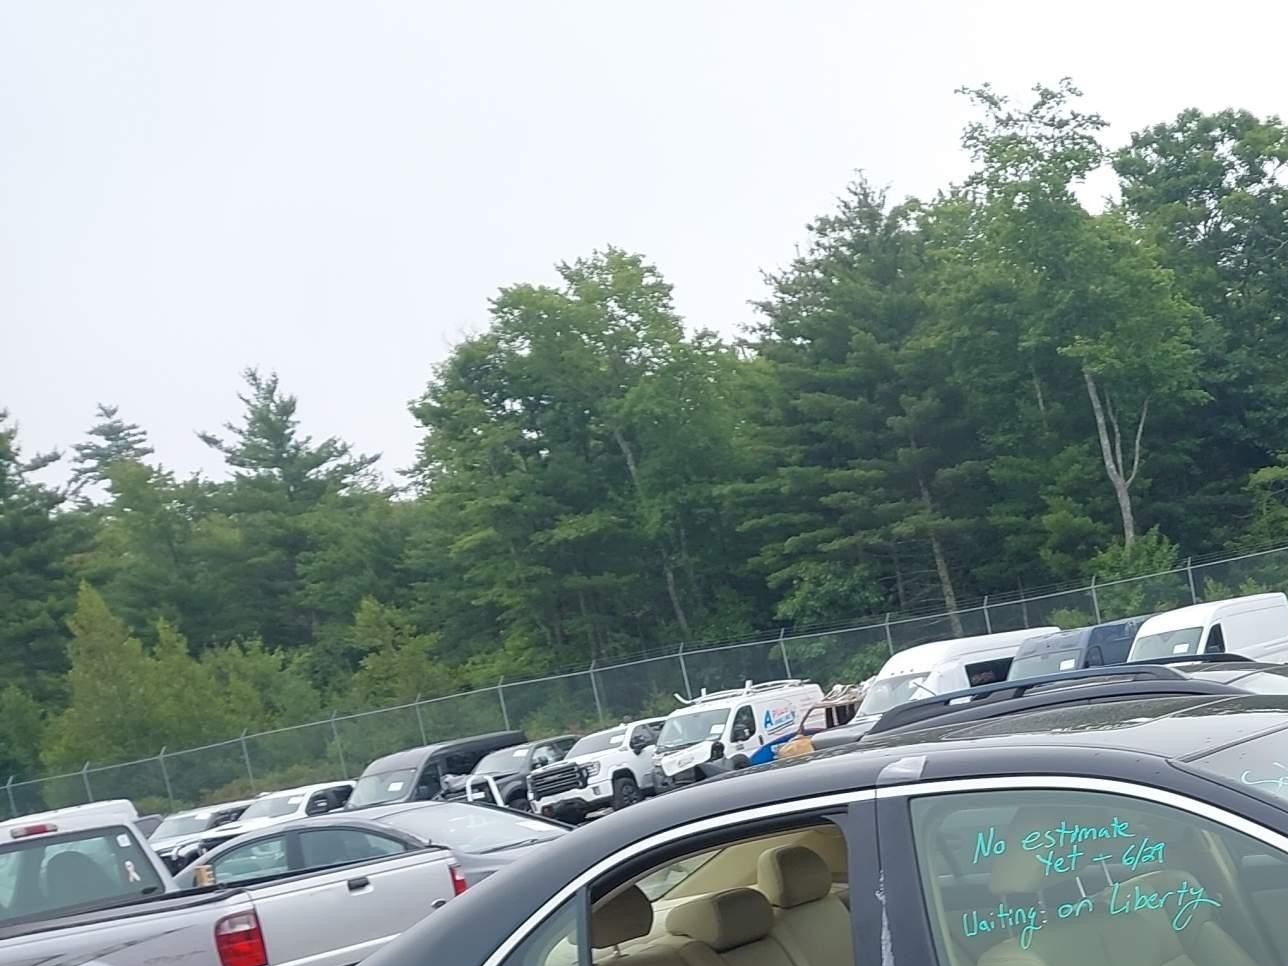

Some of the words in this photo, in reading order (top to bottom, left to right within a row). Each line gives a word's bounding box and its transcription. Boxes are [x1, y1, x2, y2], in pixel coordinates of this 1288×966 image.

[973, 827, 1006, 864] No
[1021, 816, 1137, 850] estimate
[1036, 845, 1084, 876] Yet
[1122, 838, 1166, 871] 6/29
[1057, 898, 1094, 918] on
[1110, 881, 1221, 931] Liberty
